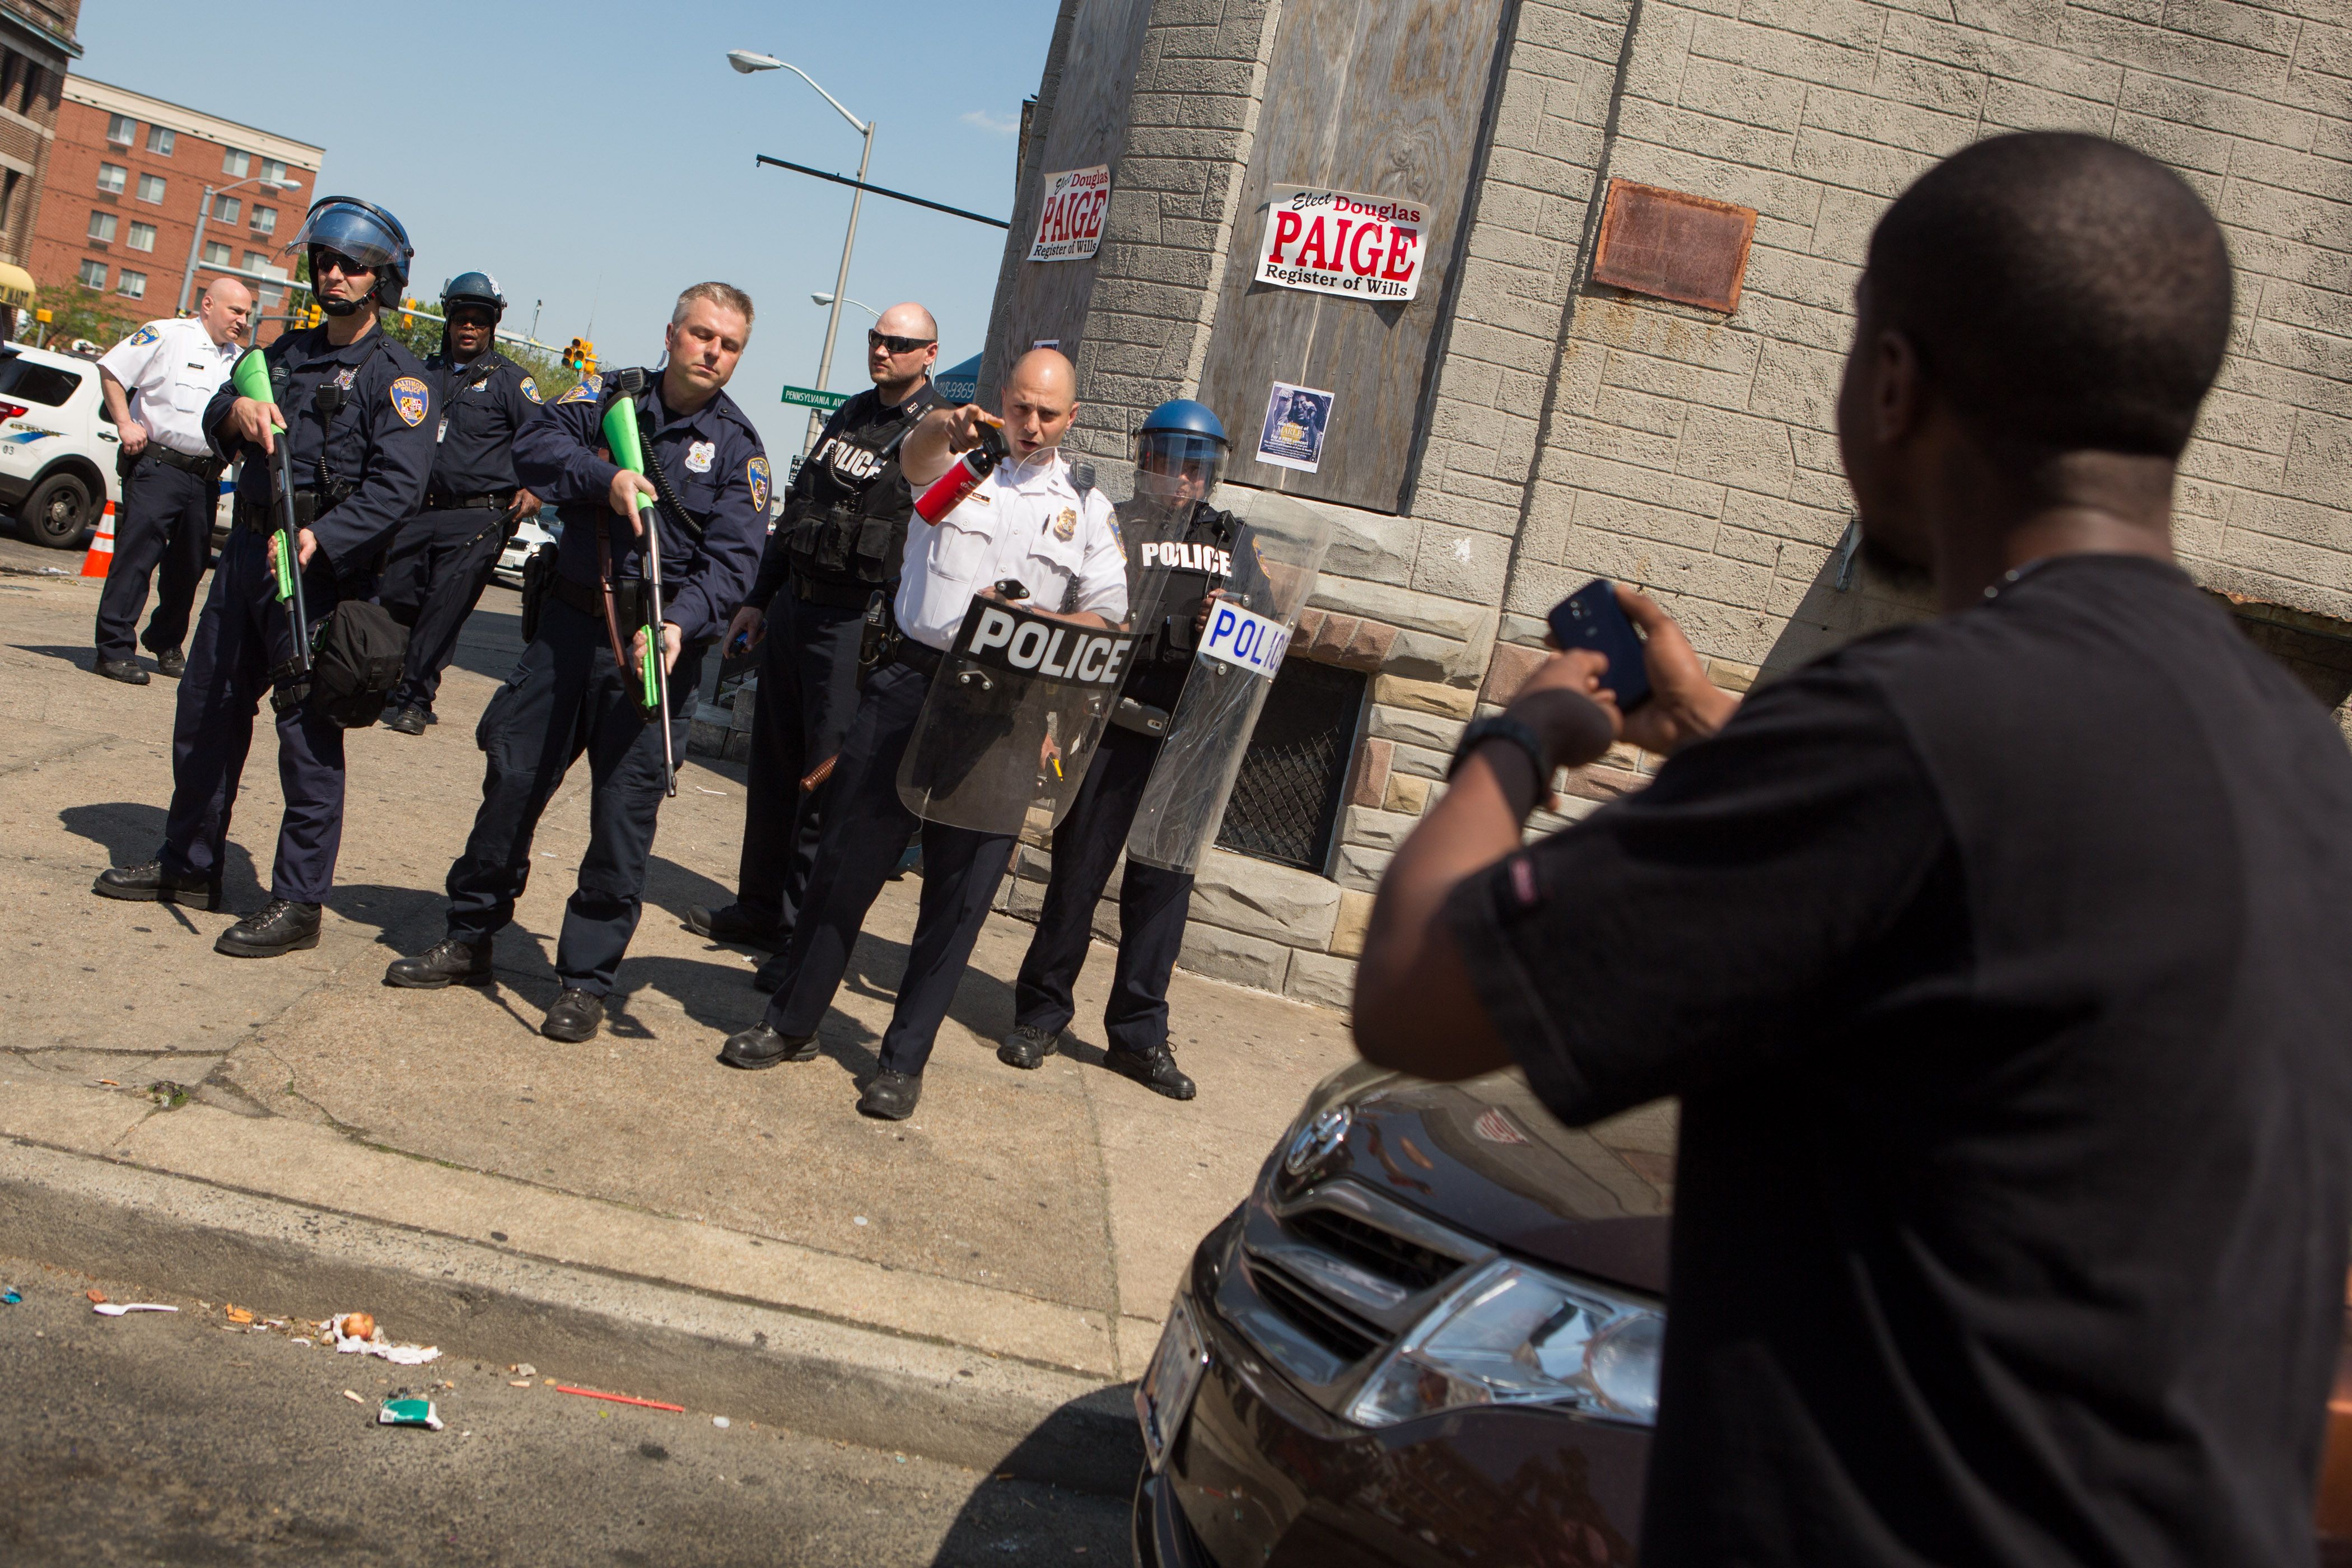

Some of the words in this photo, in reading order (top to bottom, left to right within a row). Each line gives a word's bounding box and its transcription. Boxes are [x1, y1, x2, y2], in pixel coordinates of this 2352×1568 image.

[1054, 172, 1072, 195] Elect
[1070, 170, 1108, 189] Douglas
[1039, 189, 1107, 243] PAIGE
[1291, 192, 1332, 211] Elect
[1333, 195, 1421, 223] Douglas
[1033, 243, 1068, 259] Register
[1068, 241, 1076, 254] of
[1077, 239, 1097, 253] Wills
[1268, 211, 1417, 282] PAIGE
[1264, 264, 1338, 287] Register
[1343, 277, 1362, 291] of
[1366, 278, 1408, 296] Wills
[393, 380, 426, 393] BALTIMORE
[400, 386, 421, 395] POLICE
[785, 390, 829, 406] PENNSYLVANIA
[1277, 426, 1307, 438] MARLEY
[815, 437, 888, 480] POLICE
[1141, 541, 1233, 577] POLICE
[968, 606, 1132, 684] POLICE
